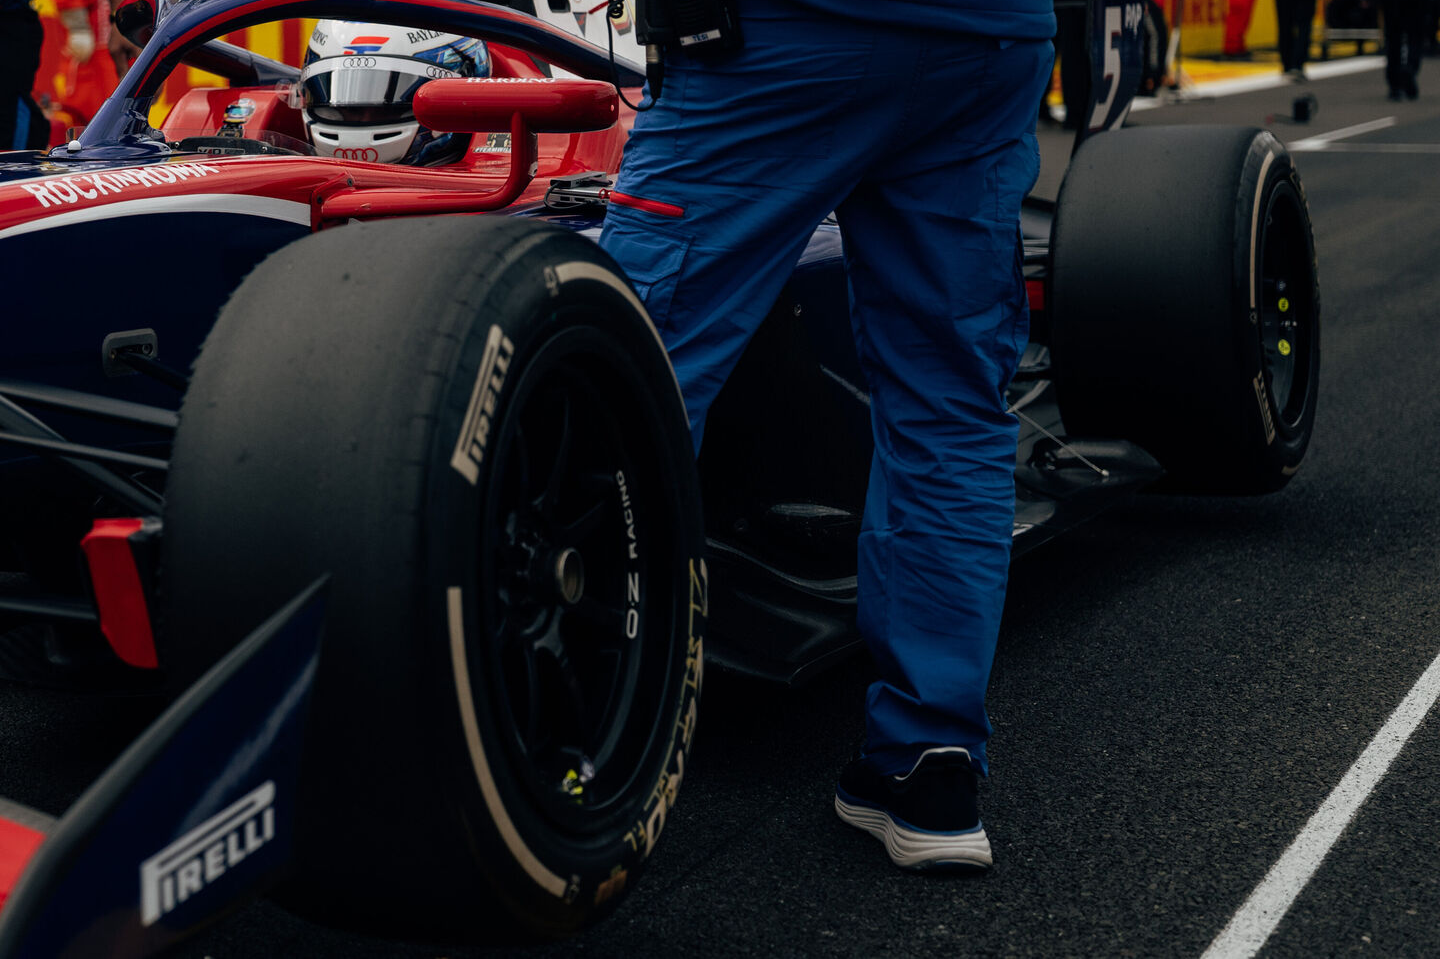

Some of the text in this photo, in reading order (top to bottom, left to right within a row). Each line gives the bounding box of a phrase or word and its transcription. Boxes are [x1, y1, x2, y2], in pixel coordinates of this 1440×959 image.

[1088, 6, 1122, 130] 5
[450, 324, 515, 486] PIRELLI
[616, 470, 639, 560] RACING
[139, 778, 277, 928] PIRELLI
